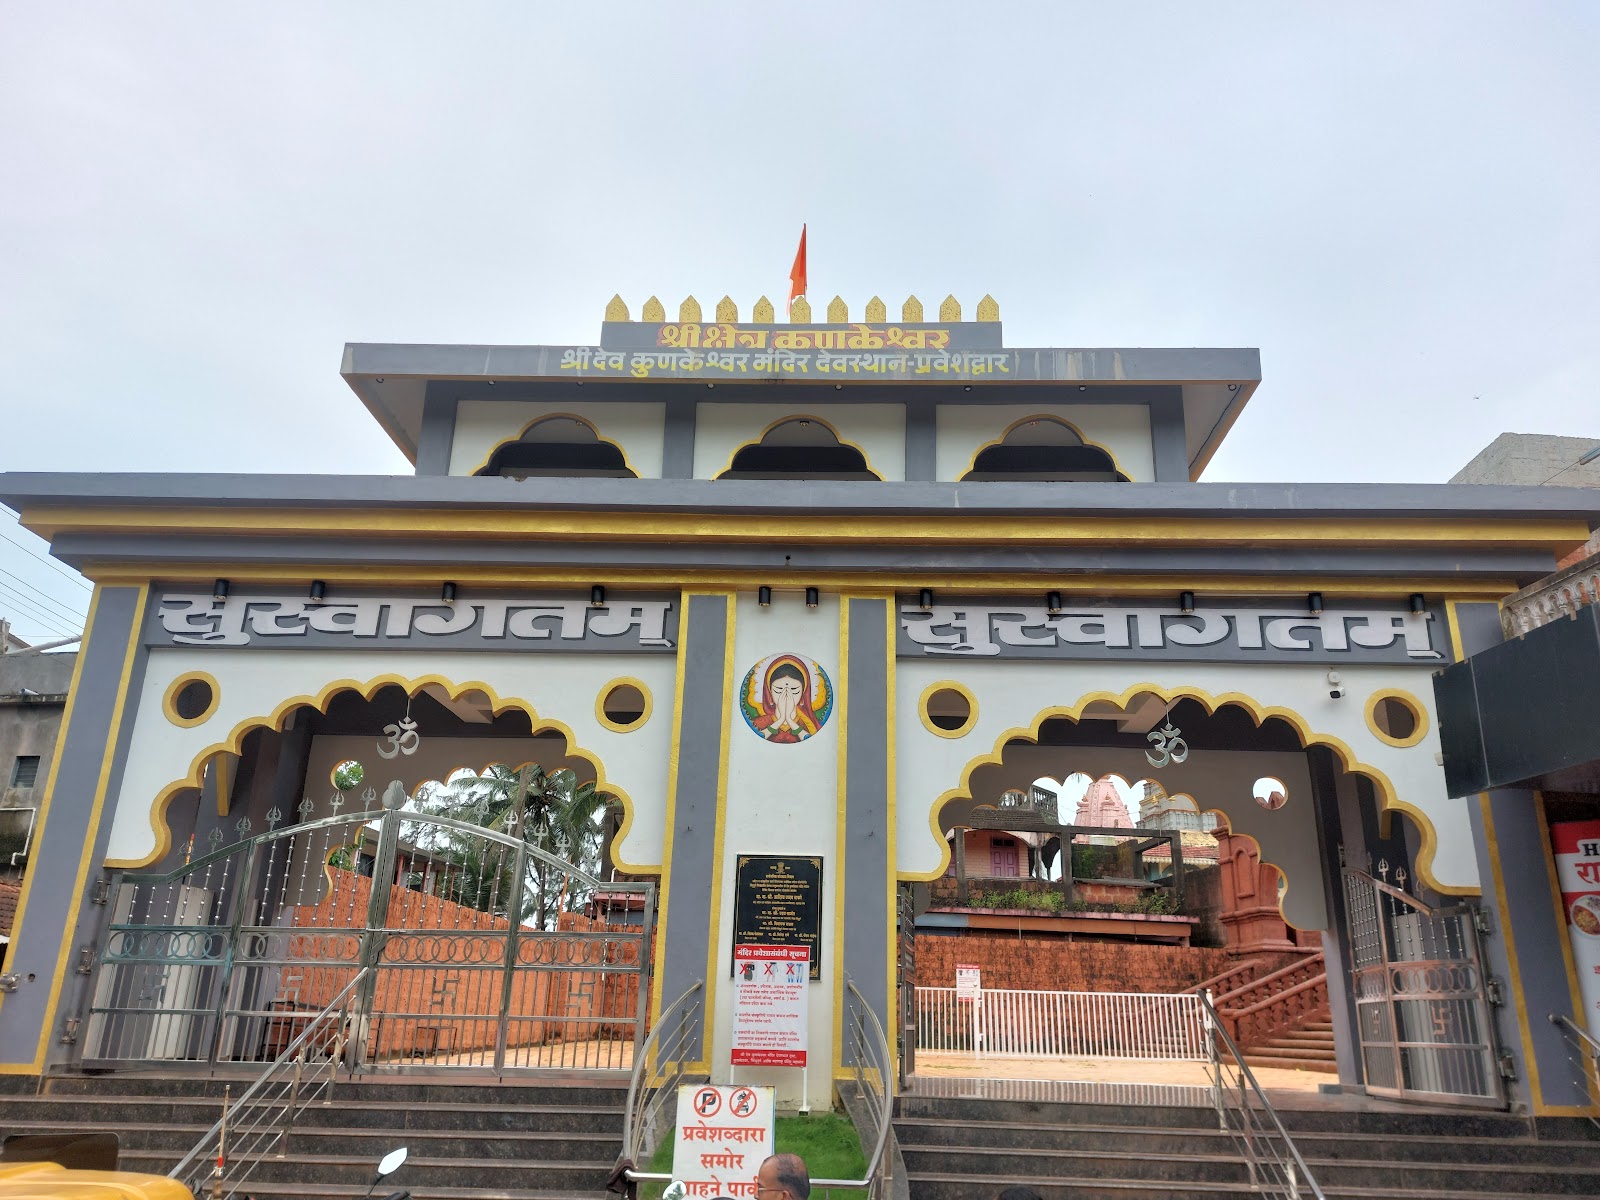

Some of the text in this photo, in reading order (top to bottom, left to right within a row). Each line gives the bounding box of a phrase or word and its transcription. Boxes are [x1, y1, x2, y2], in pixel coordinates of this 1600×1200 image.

[630, 347, 750, 378] कुणकेश्वर
[752, 347, 812, 374] मंदिर
[157, 592, 675, 648] सुस्वागतम्
[899, 603, 1445, 660] सुस्वागतम्
[700, 1148, 745, 1170] समोर
